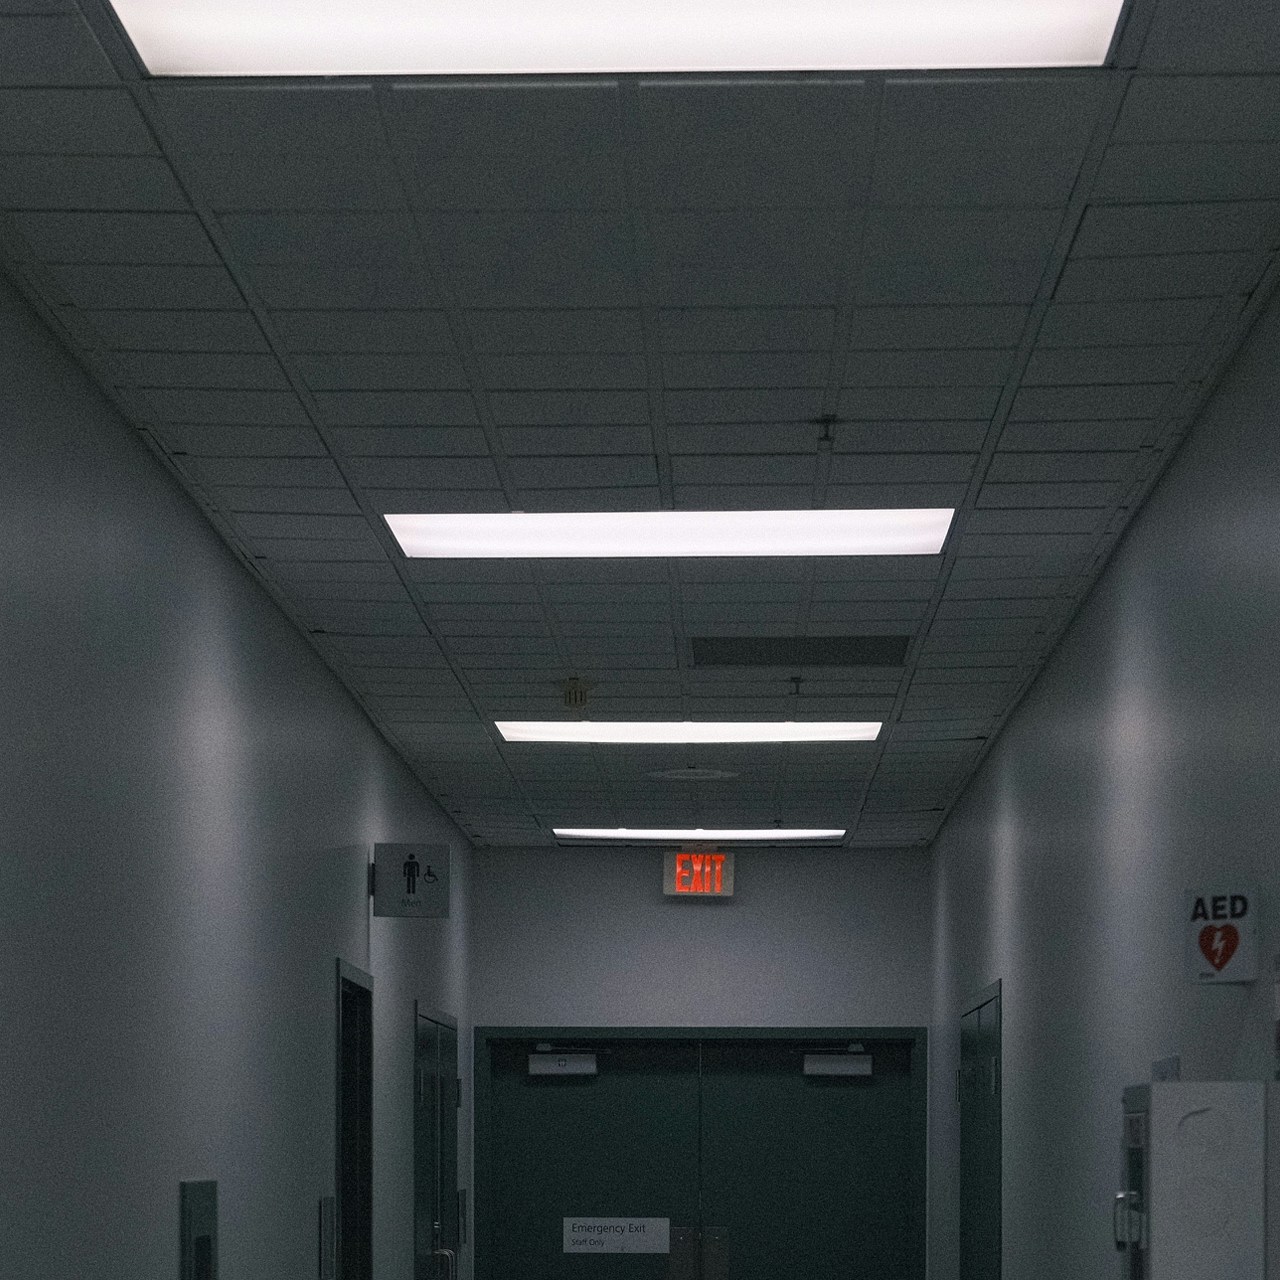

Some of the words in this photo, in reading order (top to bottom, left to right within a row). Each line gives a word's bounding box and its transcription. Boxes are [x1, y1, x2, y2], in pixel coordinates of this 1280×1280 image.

[675, 853, 727, 893] EXIT
[1190, 894, 1249, 922] AED
[572, 1223, 626, 1235] Emergency
[628, 1223, 646, 1233] Exit
[589, 1239, 605, 1247] Only
